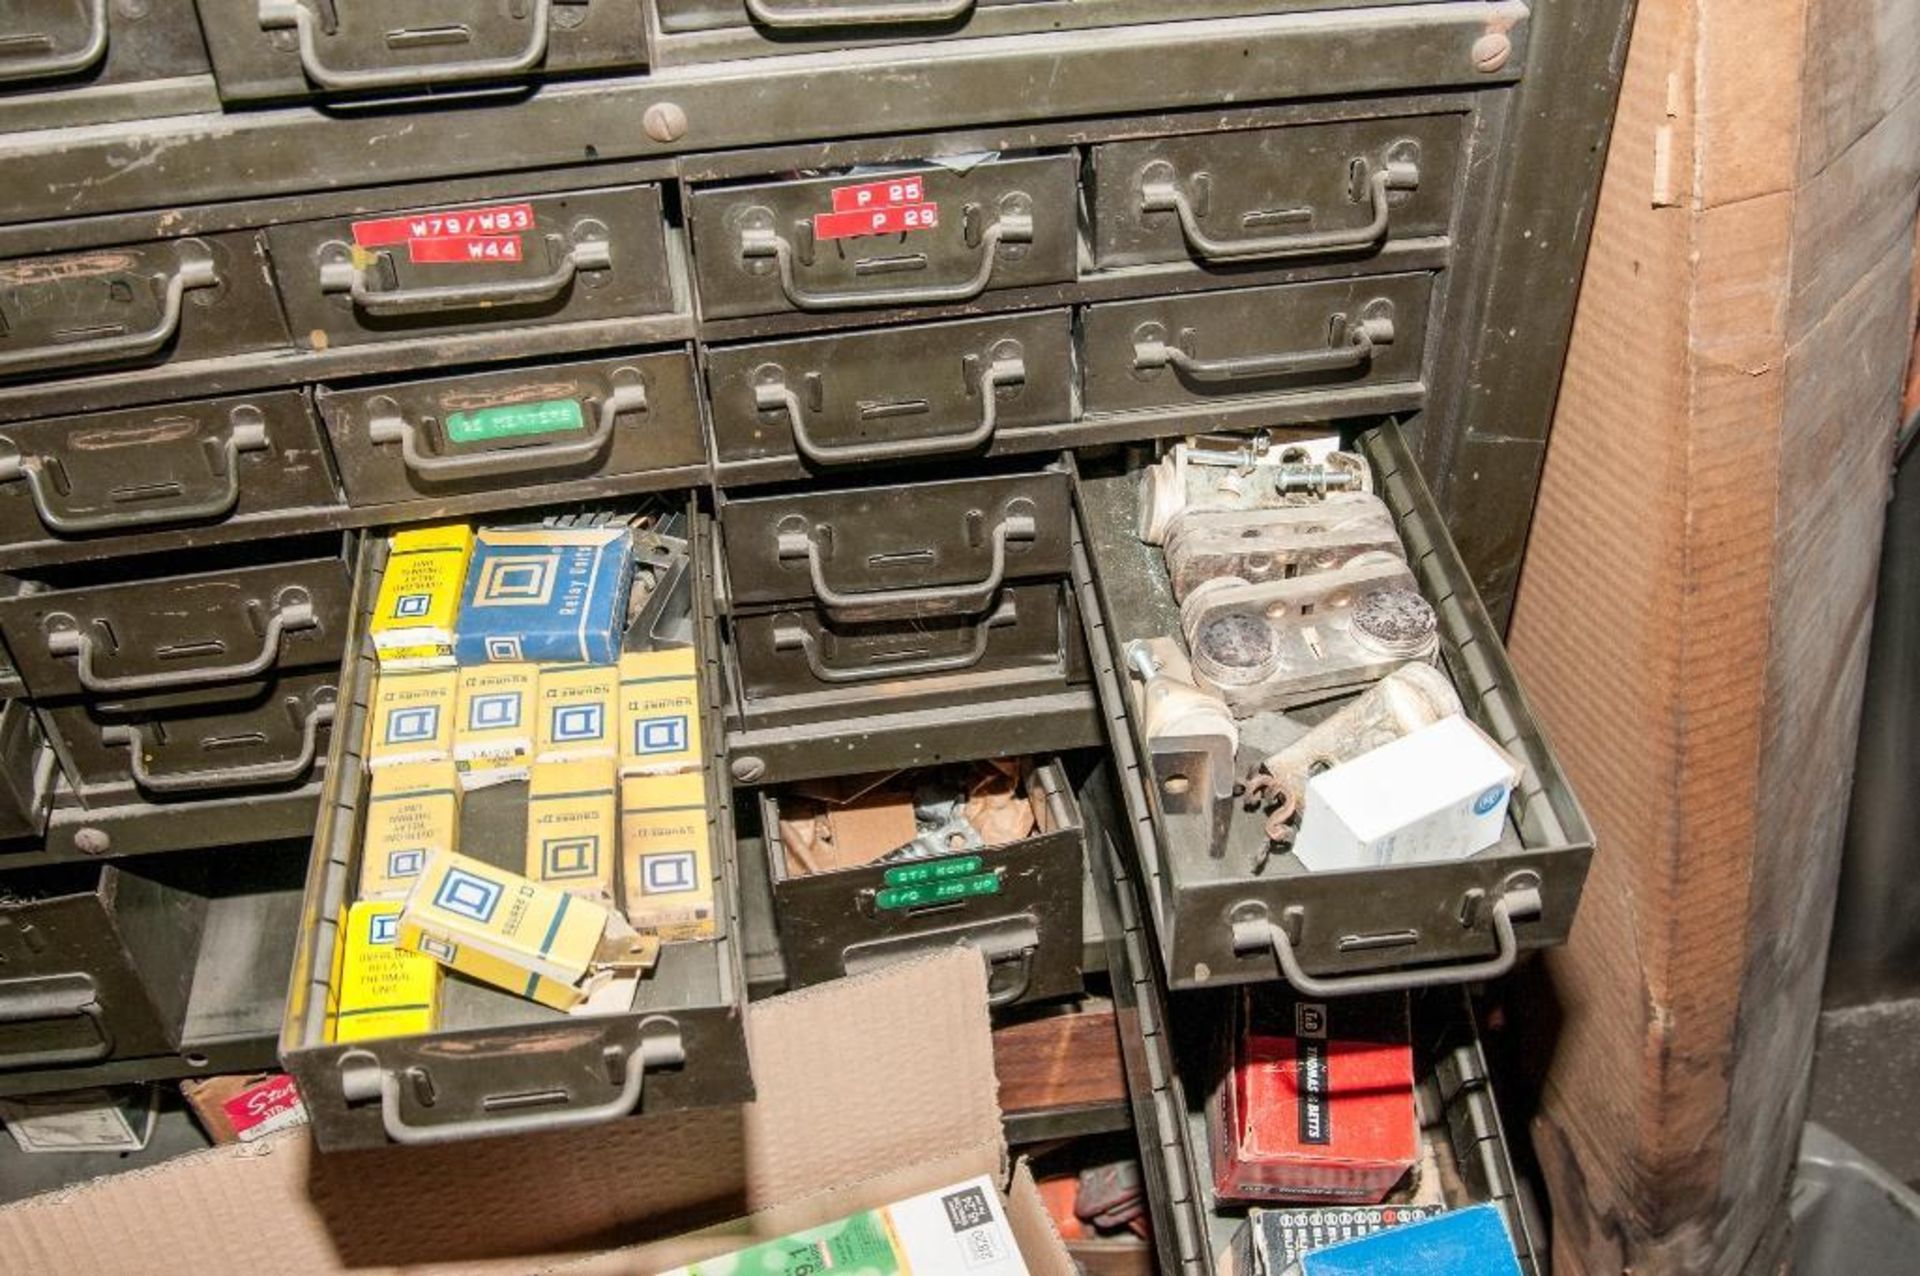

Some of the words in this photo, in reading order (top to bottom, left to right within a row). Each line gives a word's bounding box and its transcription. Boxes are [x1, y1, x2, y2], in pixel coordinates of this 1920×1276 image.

[857, 190, 872, 206] P
[889, 183, 919, 201] 25
[410, 210, 528, 237] W79/W83
[872, 212, 887, 229] P
[904, 208, 934, 226] 29
[468, 241, 517, 258] W44
[559, 578, 587, 615] Relay
[1306, 1046, 1320, 1092] THOMAS
[1307, 1103, 1321, 1138] BETTS
